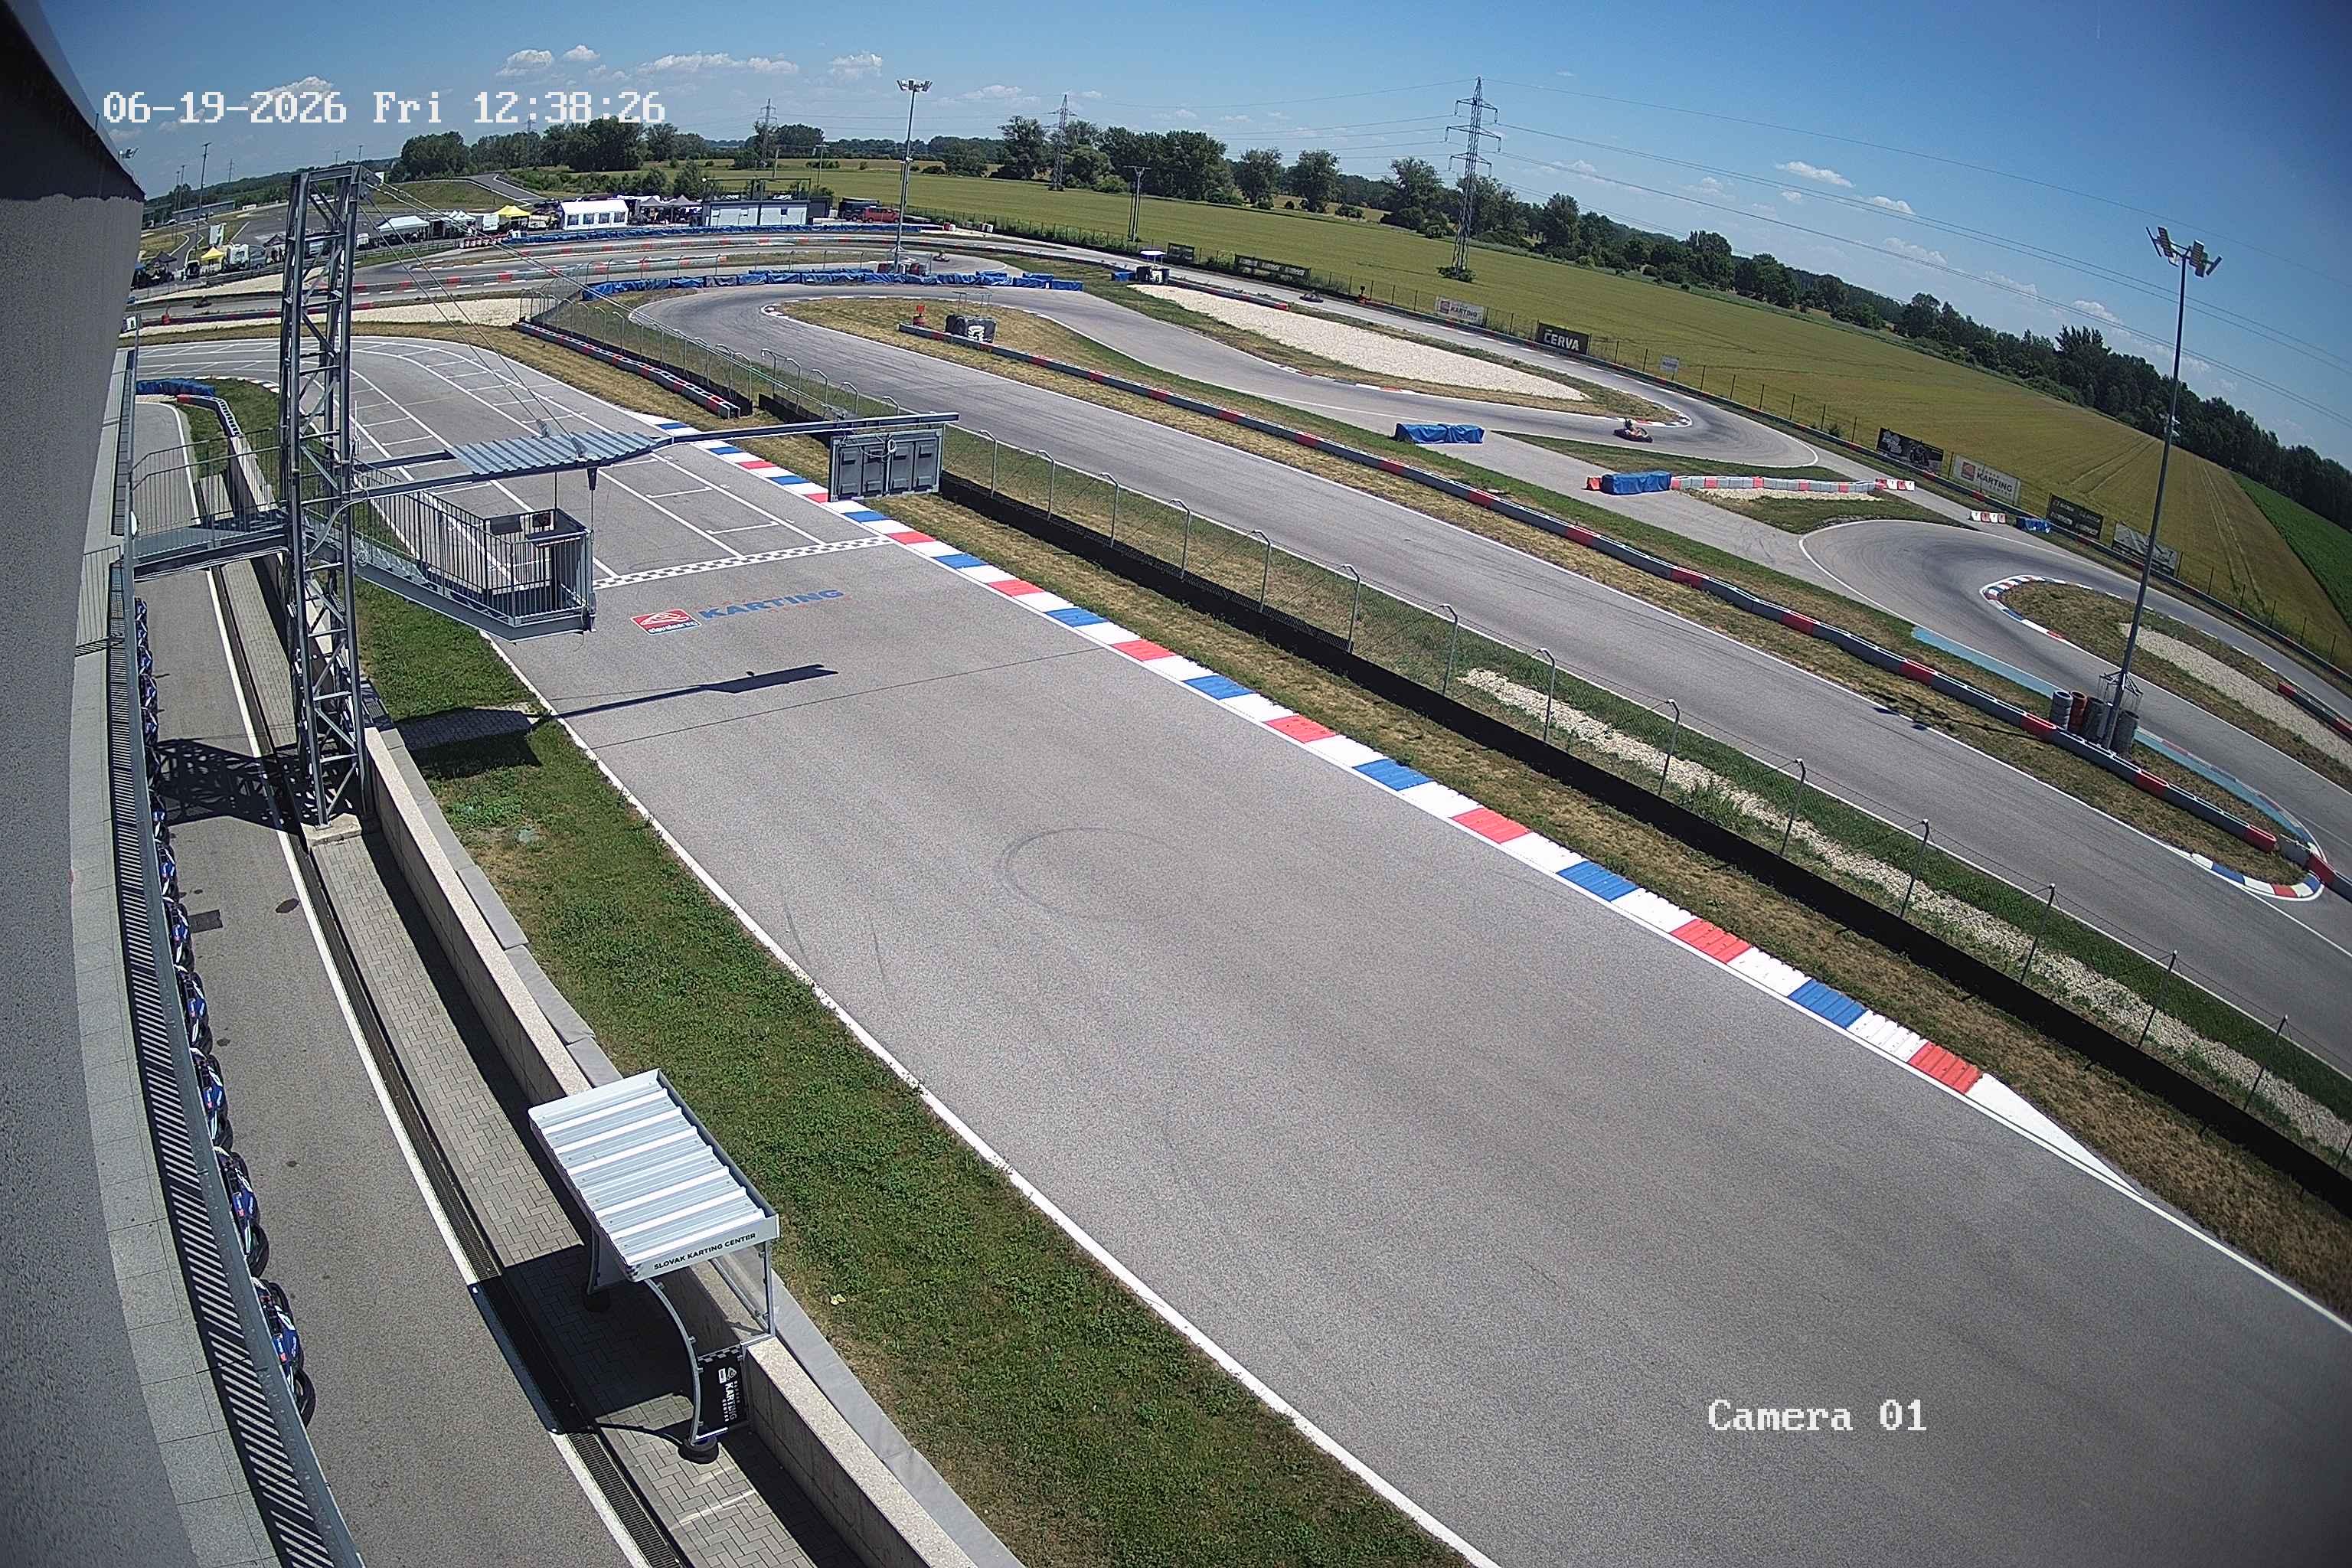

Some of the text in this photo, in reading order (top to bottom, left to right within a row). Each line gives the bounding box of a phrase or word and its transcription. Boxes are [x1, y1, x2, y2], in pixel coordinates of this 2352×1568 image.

[1977, 472, 2012, 492] KARTING
[697, 589, 844, 619] KARTING
[654, 1233, 756, 1270] SLOVAK KARTING CENTER
[725, 1381, 738, 1420] KARTING
